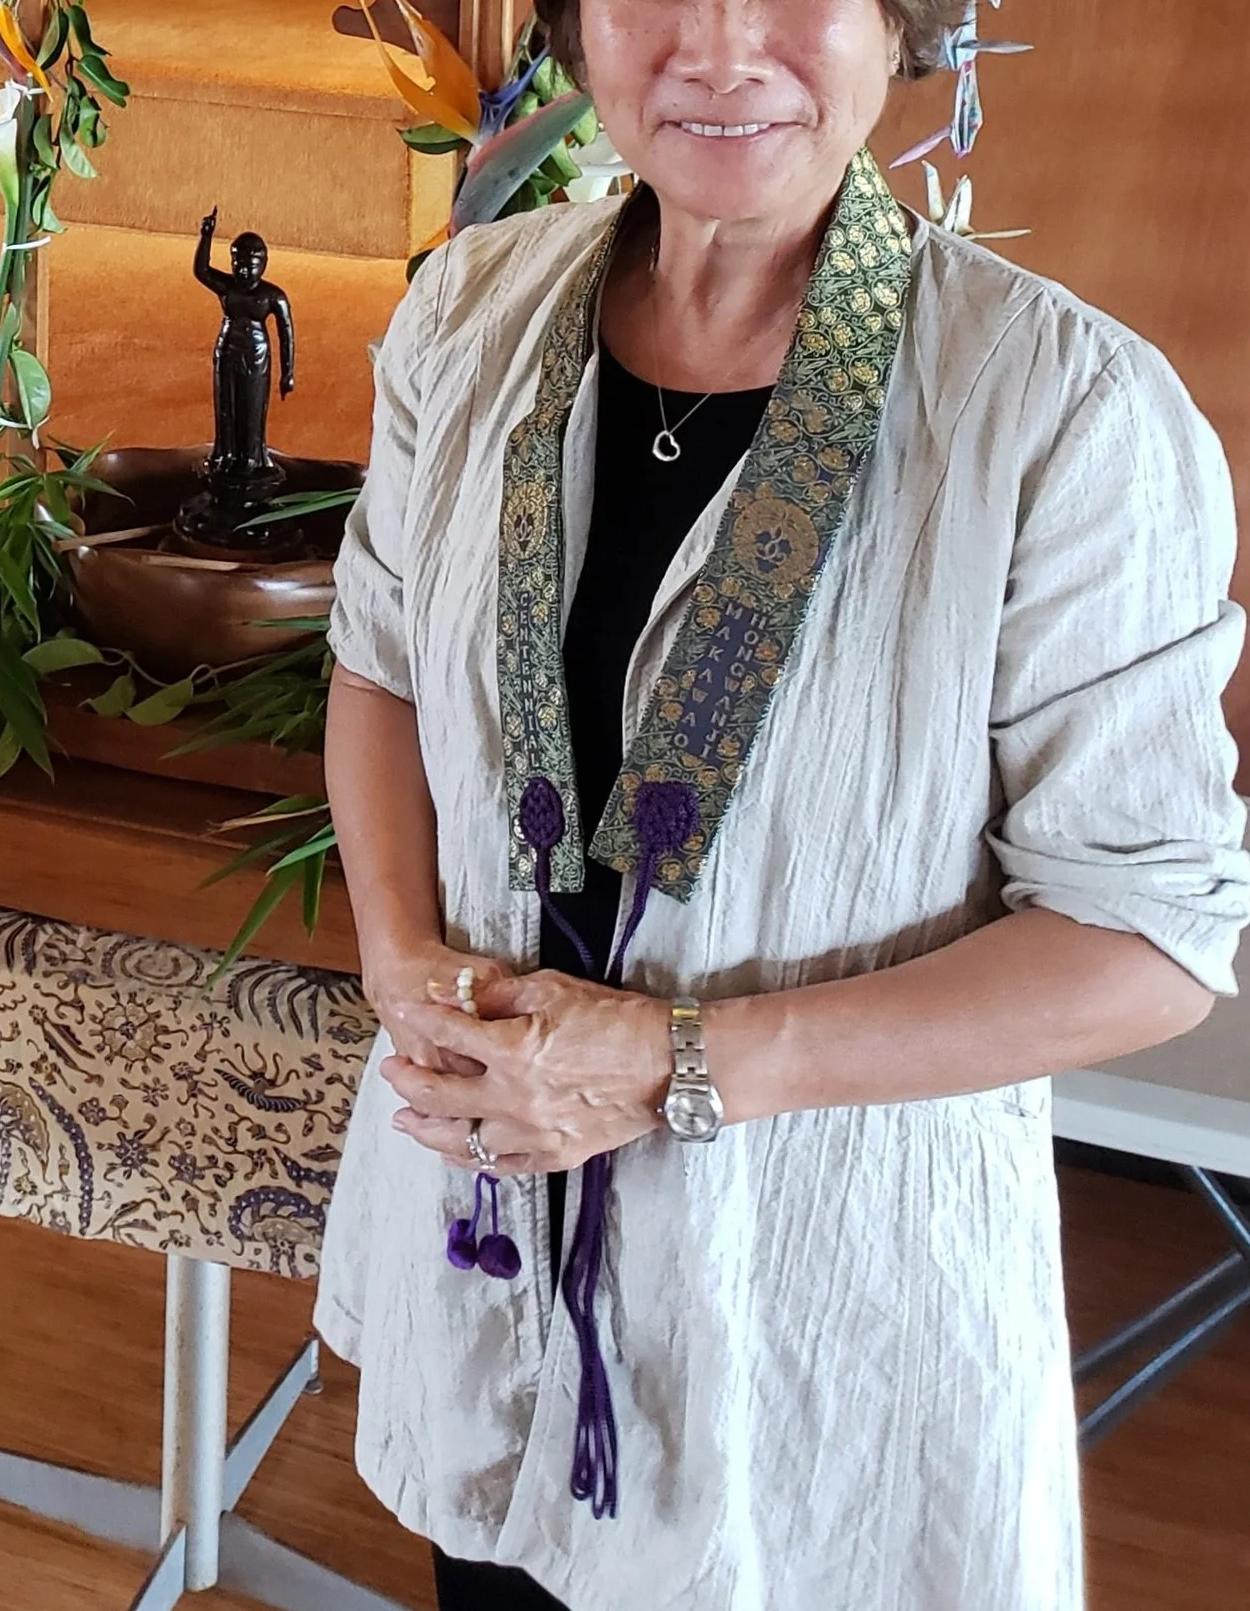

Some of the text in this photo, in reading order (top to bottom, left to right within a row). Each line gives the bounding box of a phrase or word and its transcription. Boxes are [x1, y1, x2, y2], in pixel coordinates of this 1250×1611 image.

[519, 593, 540, 767] CENTENNIAL
[674, 602, 743, 749] MAKAWAO
[700, 612, 767, 759] HONGWANJI
